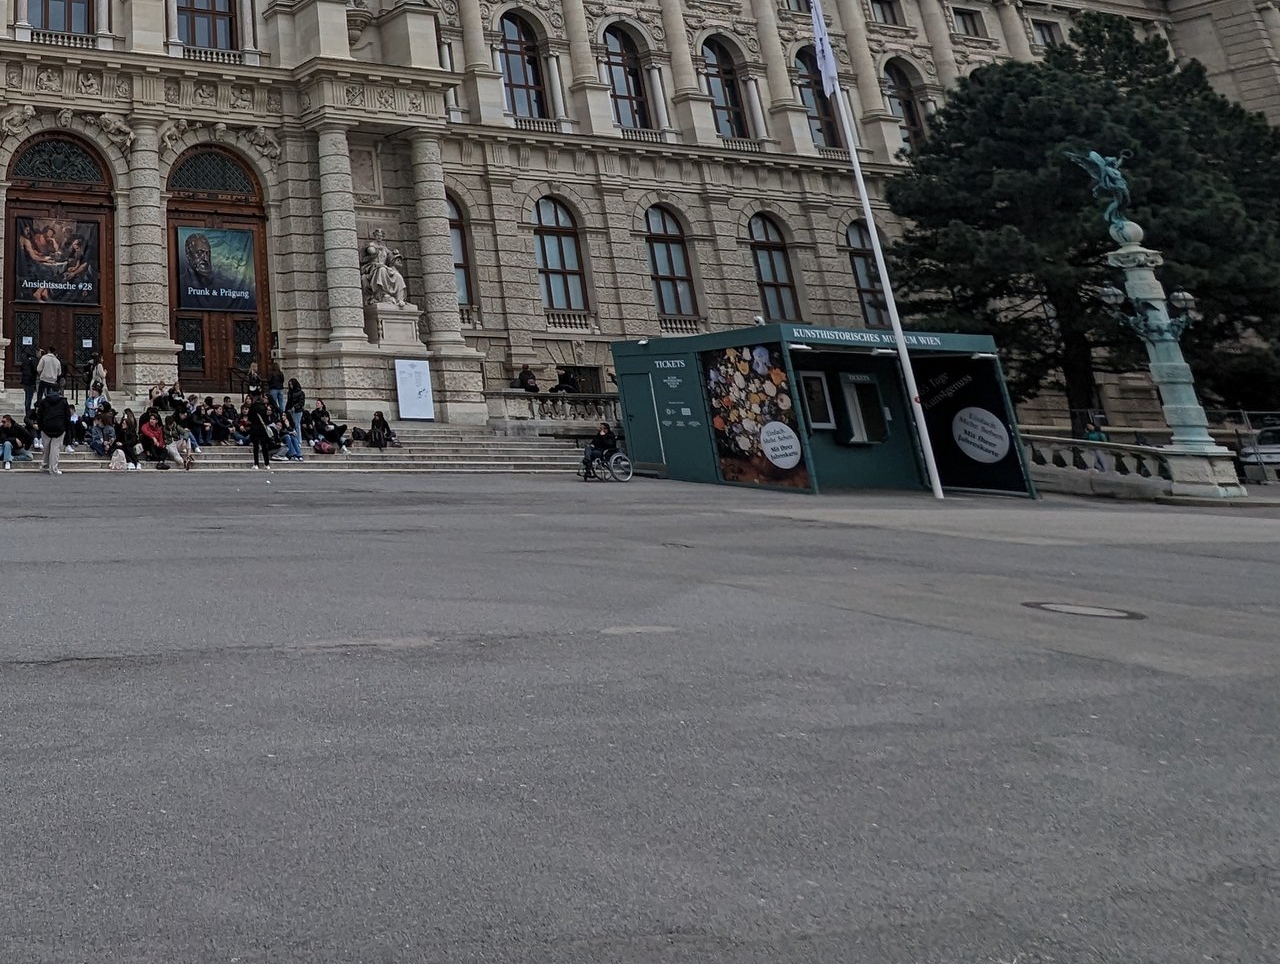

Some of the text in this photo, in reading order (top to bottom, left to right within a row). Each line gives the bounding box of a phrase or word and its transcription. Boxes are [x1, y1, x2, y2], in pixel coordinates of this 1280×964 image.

[21, 279, 93, 291] Ansichtssache #28
[187, 286, 210, 296] Prunk
[220, 288, 250, 299] Prägung
[792, 328, 942, 346] KUNSTHISTORISCHES MUUM WIEN
[654, 359, 686, 368] TICKETS
